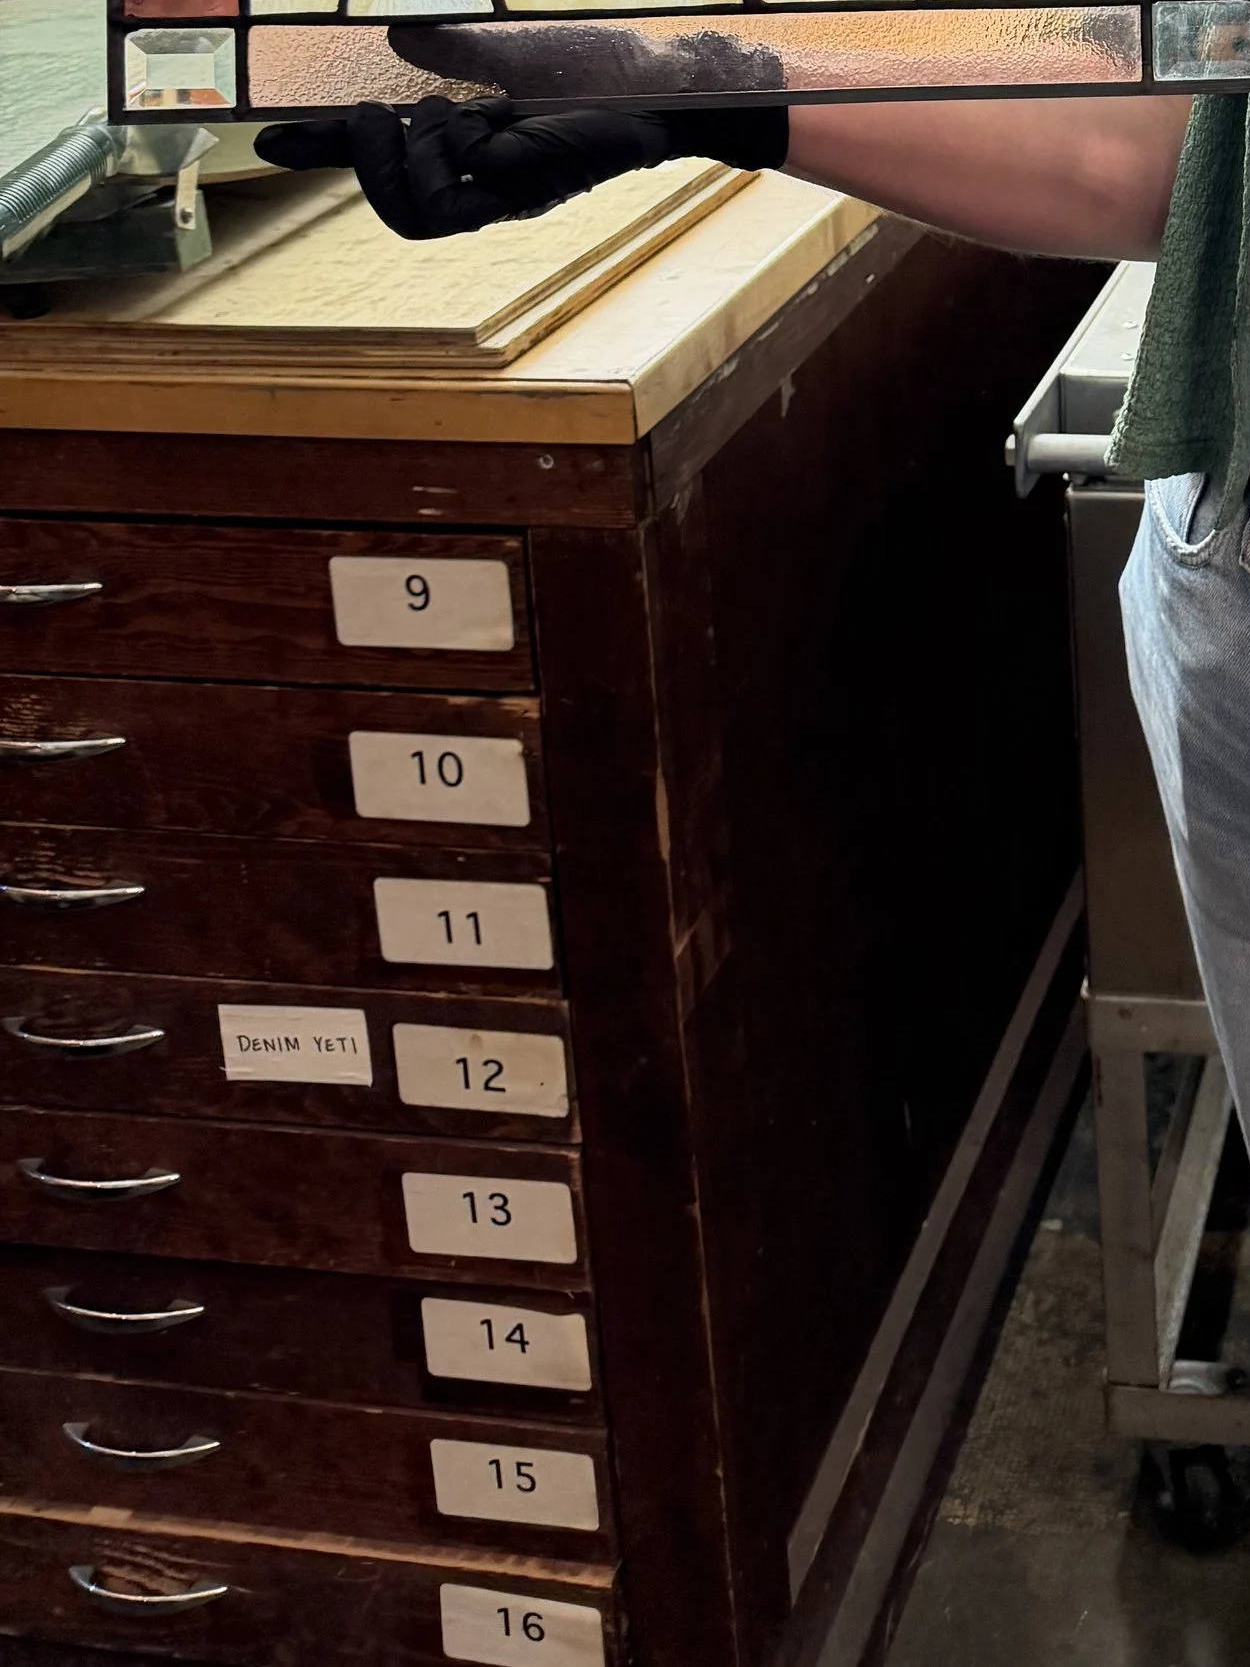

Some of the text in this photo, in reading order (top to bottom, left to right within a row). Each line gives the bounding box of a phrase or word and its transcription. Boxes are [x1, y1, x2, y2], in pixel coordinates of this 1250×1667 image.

[405, 574, 431, 612] 9
[410, 750, 464, 788] 10
[437, 910, 482, 946] 11
[236, 1034, 358, 1055] DENIM YETI
[455, 1057, 506, 1093] 12
[462, 1191, 512, 1227] 13
[479, 1318, 530, 1354] 14
[488, 1458, 537, 1493] 15
[496, 1607, 546, 1642] 16
